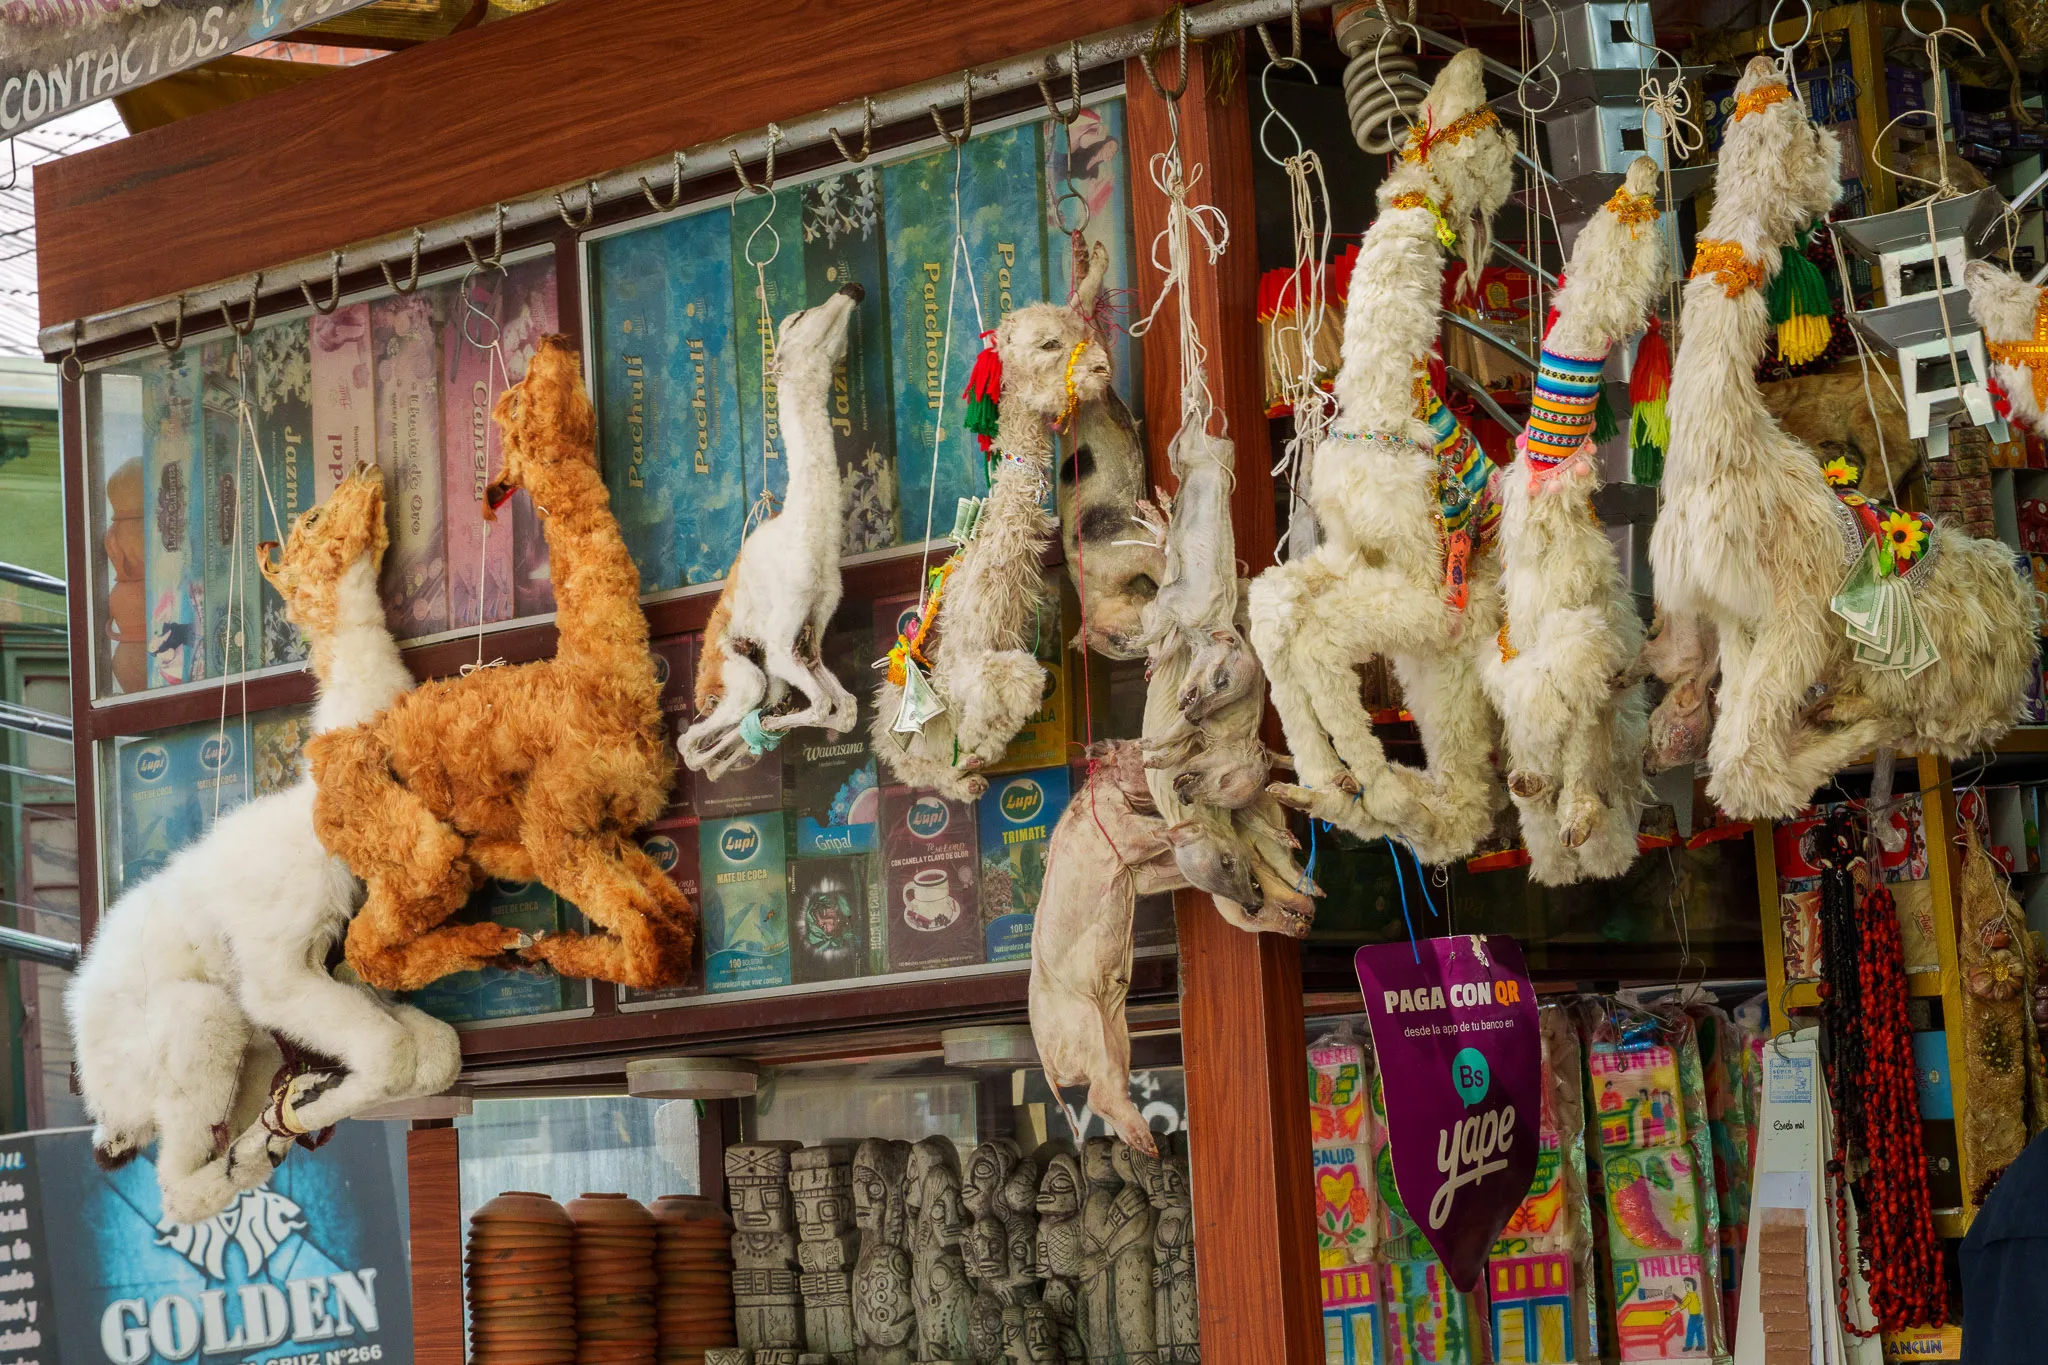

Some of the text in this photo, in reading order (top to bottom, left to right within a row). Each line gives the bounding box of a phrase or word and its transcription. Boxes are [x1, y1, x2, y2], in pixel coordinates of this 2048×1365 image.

[0, 6, 236, 130] CONTACTOS:
[923, 261, 944, 410] Patchouli
[686, 338, 709, 475] Pachulí
[622, 353, 644, 489] Pachulí
[472, 380, 490, 502] Canela
[410, 464, 422, 490] de
[411, 494, 423, 536] Oro
[806, 741, 864, 762] Wawasana
[1006, 792, 1038, 811] Lupi
[913, 808, 944, 828] Lupi
[725, 836, 756, 852] Lupi
[815, 831, 853, 853] Gripal
[1002, 825, 1047, 845] TRIMATE
[891, 859, 902, 867] CON
[902, 856, 924, 866] CANELA
[928, 853, 945, 862] CLAVO
[945, 852, 954, 860] DE
[716, 869, 768, 885] MATE DE COCA
[869, 882, 882, 950] HOJA DE COCA
[1010, 923, 1023, 934] 100
[728, 958, 742, 968] 100
[1383, 980, 1521, 1014] PAGA CON QR
[1404, 1018, 1514, 1038] desde la app de tu banco en
[1459, 1064, 1484, 1089] Bs
[1313, 1148, 1356, 1167] SALUD
[1429, 1105, 1516, 1230] yape
[1637, 1254, 1700, 1278] TALLER
[101, 1268, 380, 1365] GOLDEN
